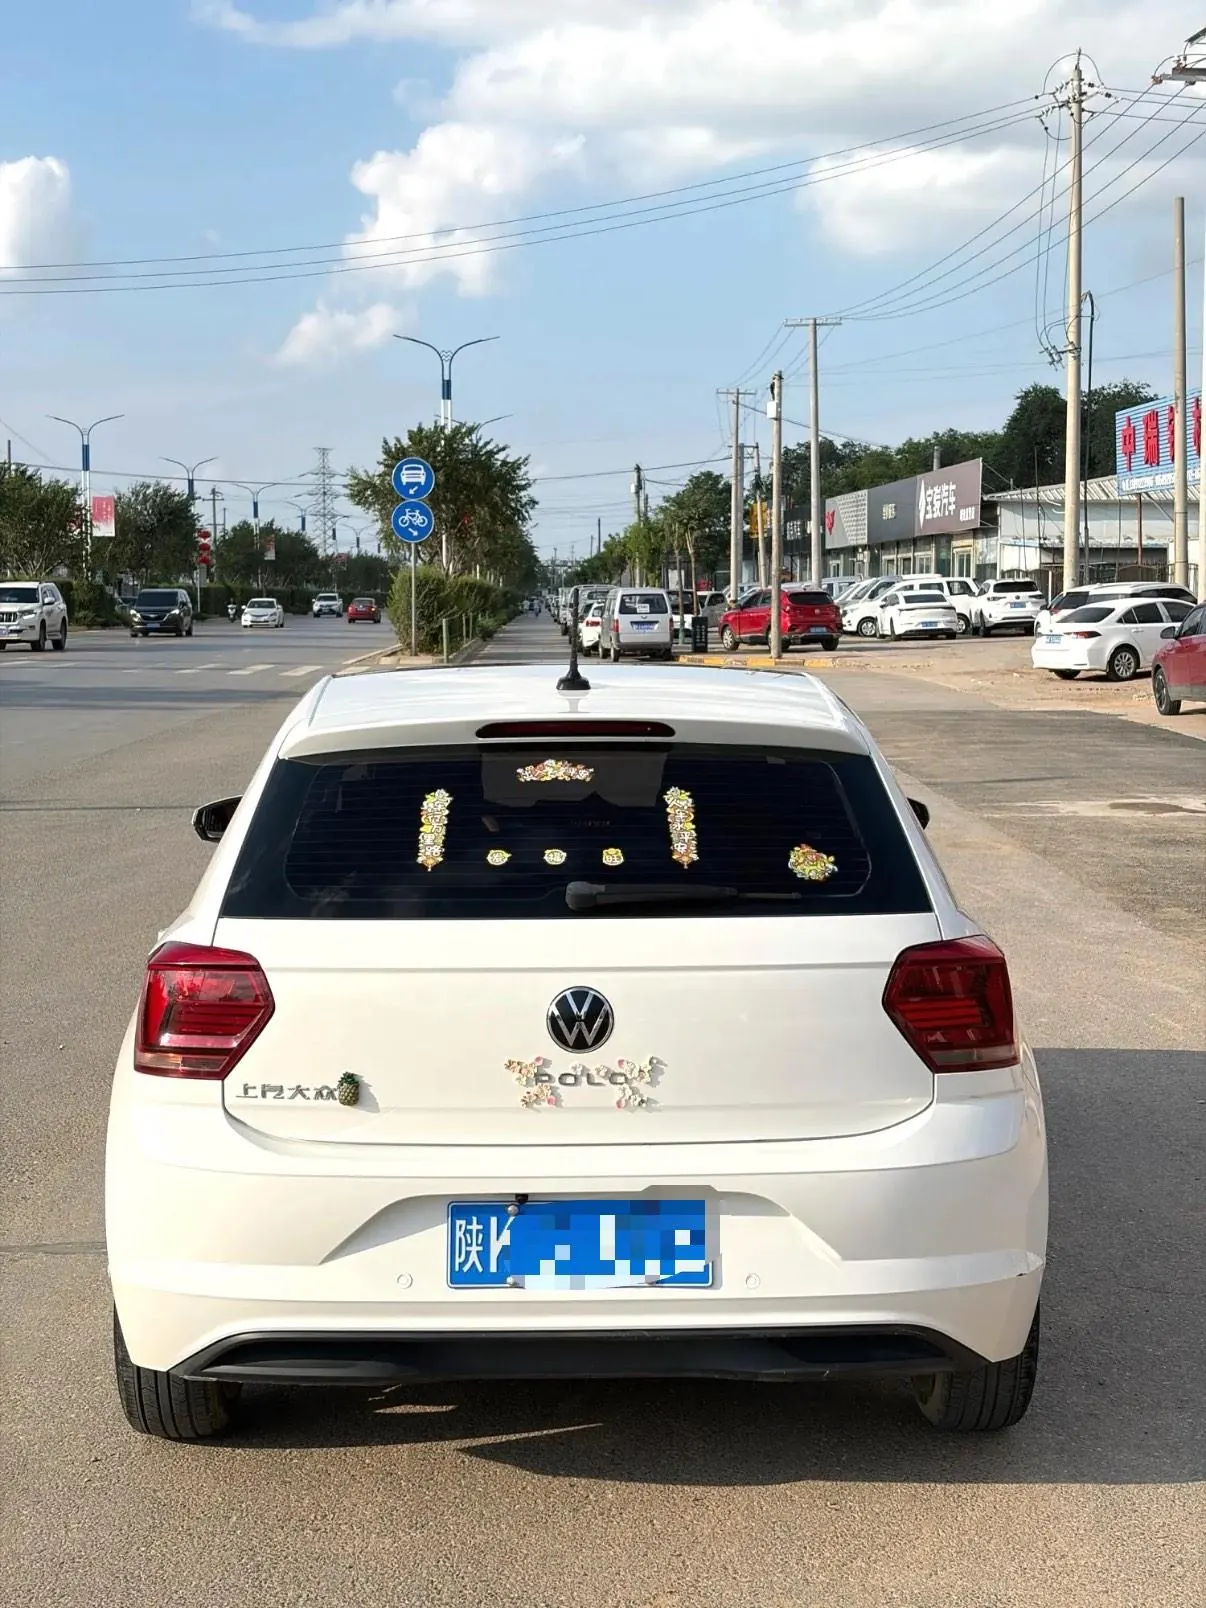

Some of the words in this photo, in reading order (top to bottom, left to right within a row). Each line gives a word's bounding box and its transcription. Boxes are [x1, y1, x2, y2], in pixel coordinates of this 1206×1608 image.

[534, 1072, 629, 1087] POLO
[235, 1082, 338, 1101] 上汽大众
